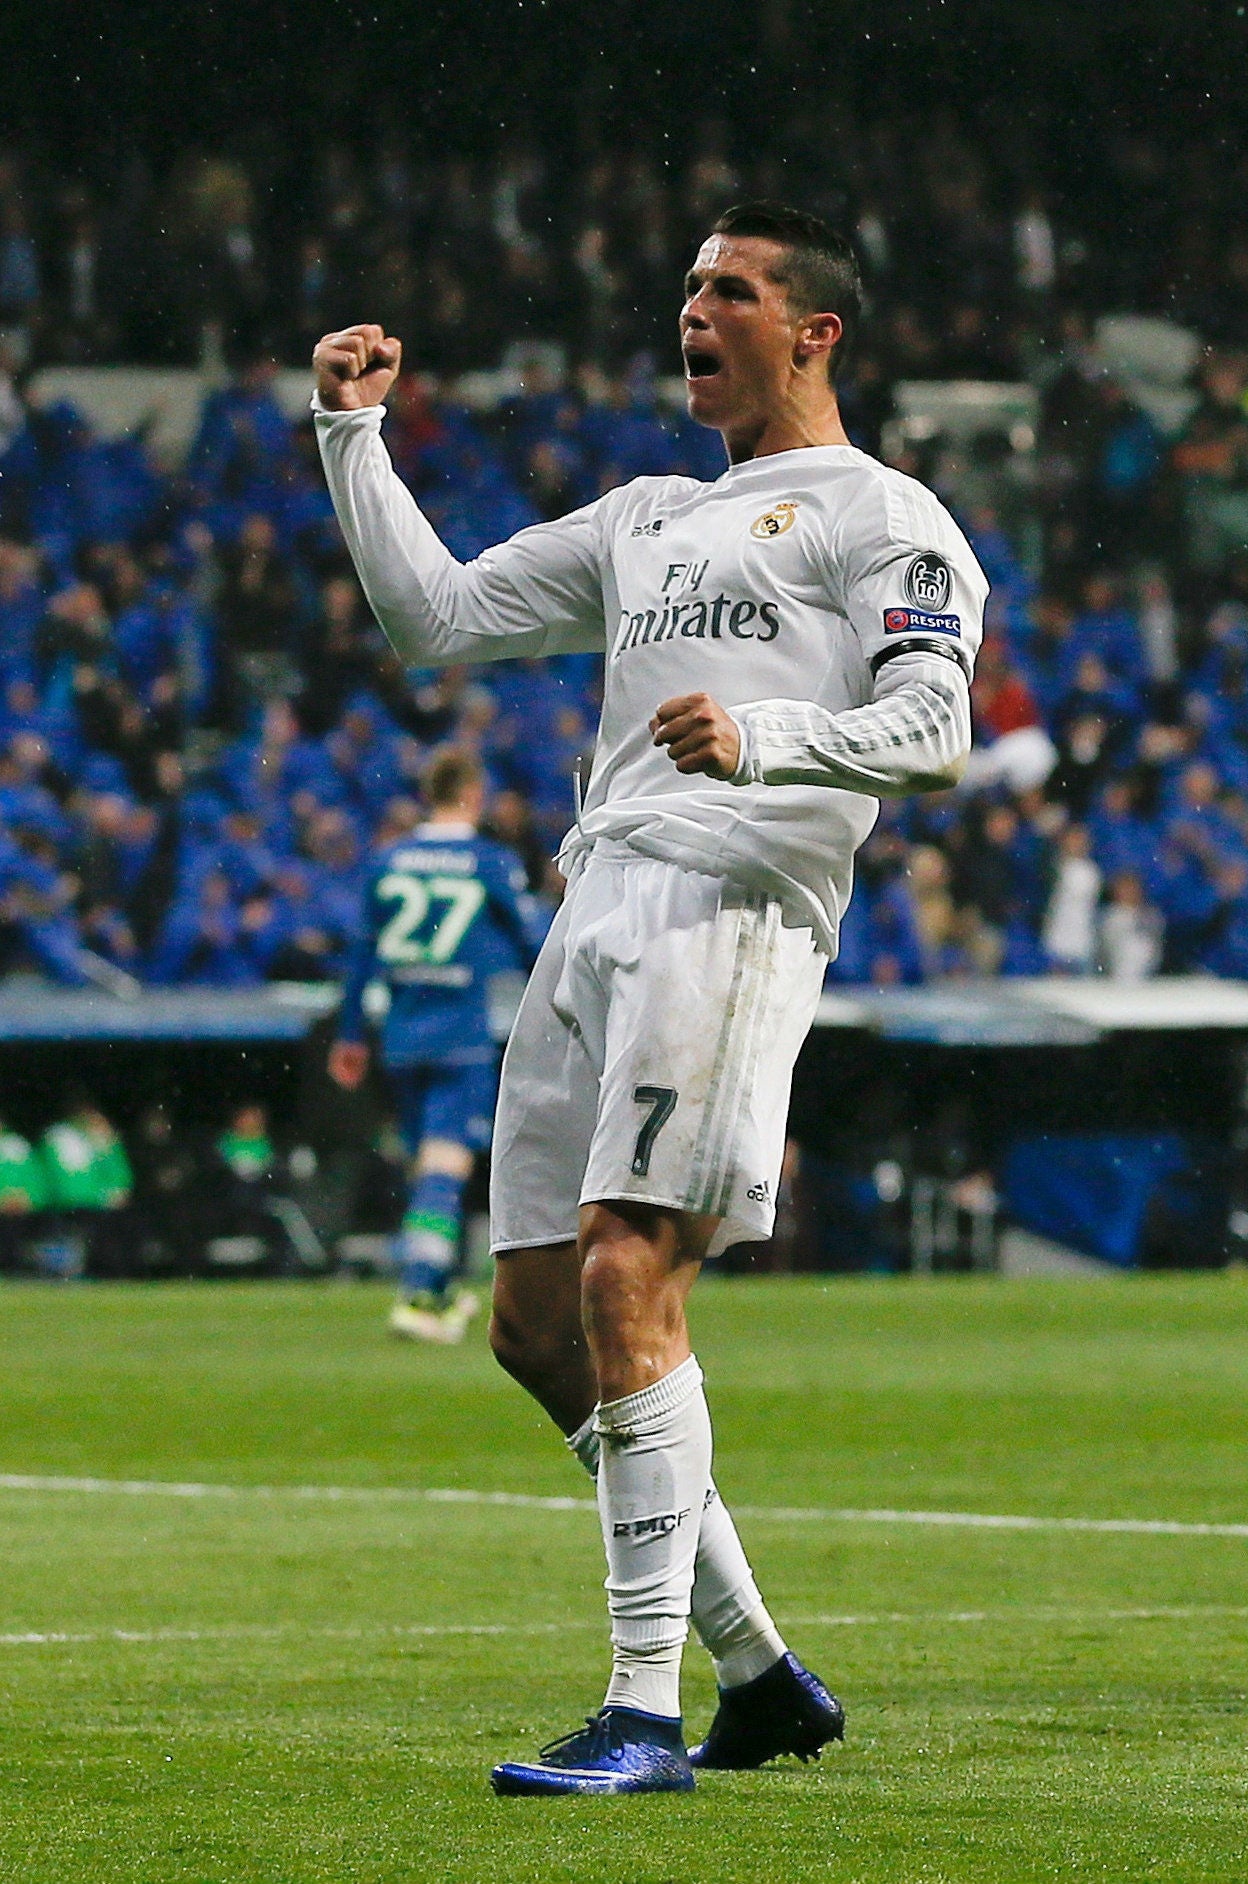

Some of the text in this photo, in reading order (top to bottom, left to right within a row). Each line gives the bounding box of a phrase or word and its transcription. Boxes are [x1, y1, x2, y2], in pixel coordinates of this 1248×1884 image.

[662, 560, 709, 592] Fly
[918, 581, 938, 601] 10
[909, 614, 960, 632] RESPEC
[375, 873, 486, 964] 27
[631, 1083, 679, 1177] 7
[612, 1507, 691, 1539] RMCF
